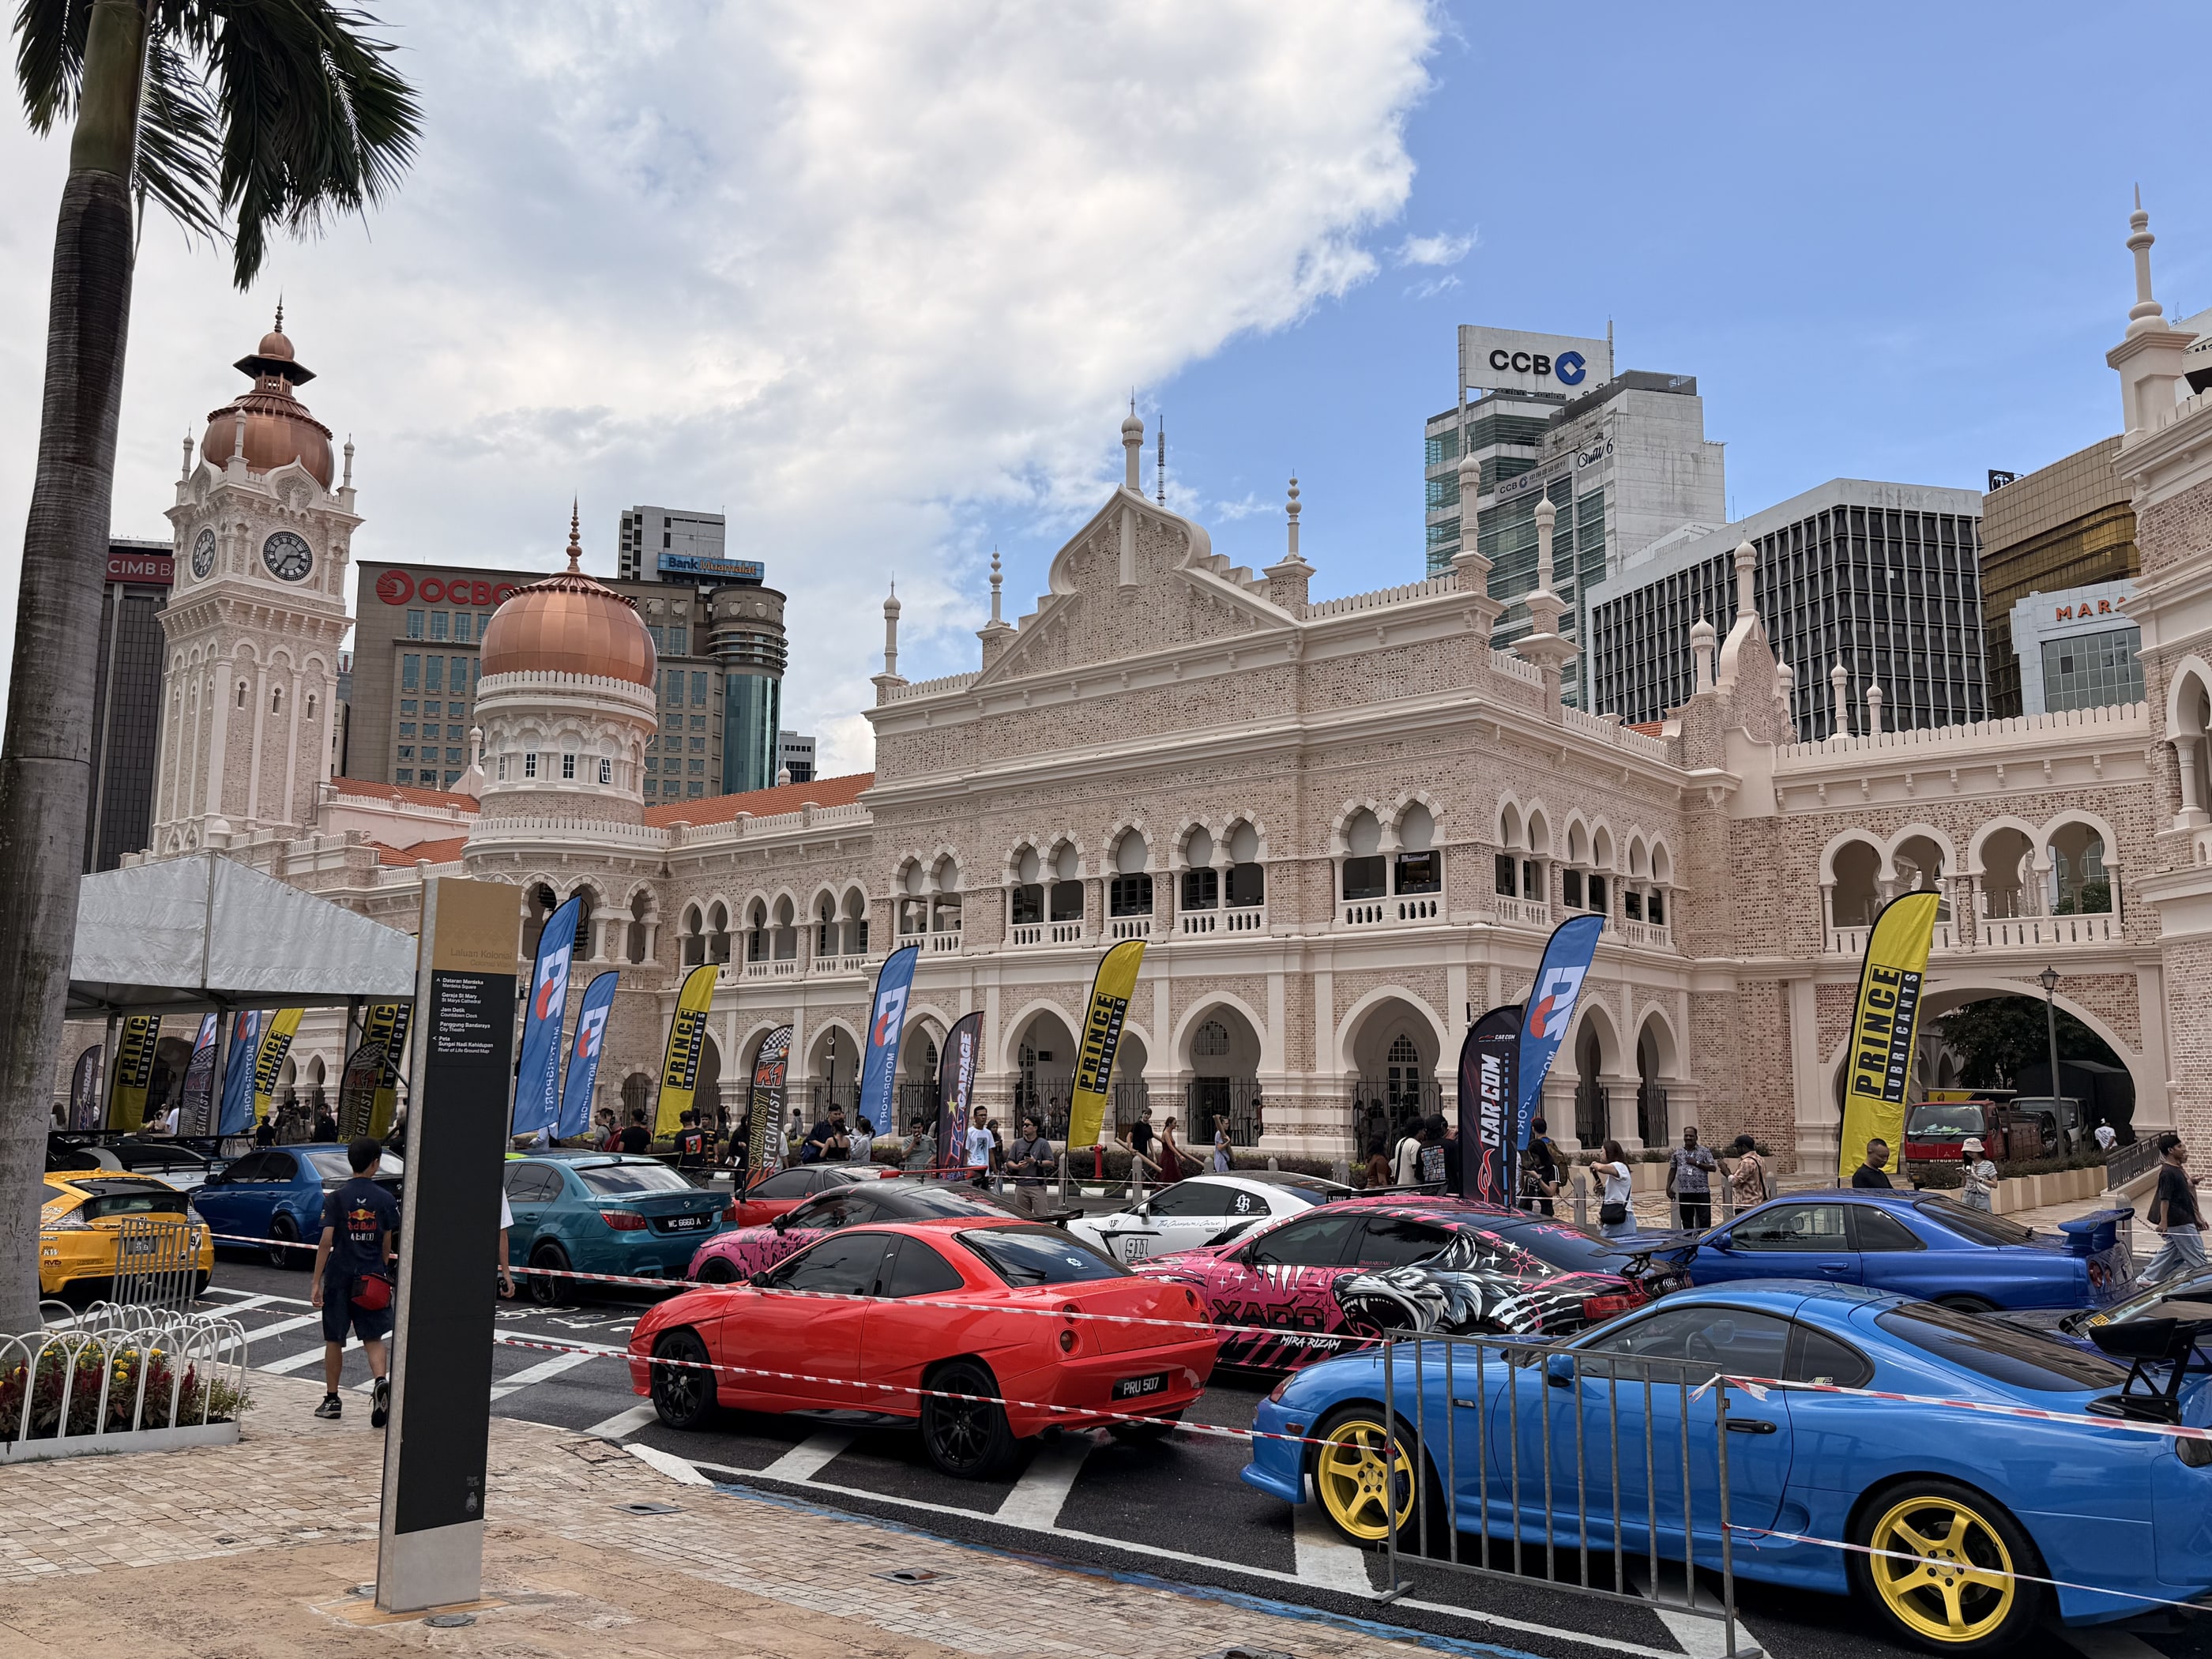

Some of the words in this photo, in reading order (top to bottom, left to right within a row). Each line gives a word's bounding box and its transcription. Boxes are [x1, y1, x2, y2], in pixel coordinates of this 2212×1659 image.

[1490, 350, 1552, 375] CCB
[1578, 445, 1605, 468] Quill
[1607, 437, 1613, 454] 6
[1499, 482, 1518, 494] CCB
[107, 560, 156, 575] CIMB
[669, 557, 698, 570] Bank
[699, 559, 757, 575] Muamalat
[419, 577, 515, 607] OCBC
[450, 948, 478, 957] Laluan
[481, 950, 513, 960] Kolonial
[120, 1016, 148, 1087] PRINC
[136, 1015, 160, 1088] LUBRICANT
[383, 1003, 410, 1088] LURICANT
[667, 1010, 697, 1088] PRINCE
[683, 1013, 705, 1089] LUBRICANTS
[1079, 995, 1115, 1090] PRINCE
[1096, 999, 1127, 1093] LUBRICANTS
[1855, 968, 1901, 1096] PRINCE
[1886, 972, 1918, 1100] LUBRICANTS
[82, 1055, 93, 1102] GARAGE
[255, 1031, 284, 1093] PRINCE
[264, 1035, 292, 1096] LUBRICANTS
[754, 1060, 786, 1089] K1
[957, 1030, 972, 1108] GARAGE
[1480, 1053, 1501, 1101] COM
[180, 1093, 201, 1136] HAUST
[195, 1092, 210, 1136] ECIALIST
[338, 1092, 360, 1139] HAUST
[356, 1092, 374, 1135] CIALIST
[748, 1089, 771, 1171] EXHAUST
[763, 1092, 781, 1168] SPECIALIST
[1480, 1104, 1501, 1147] CAR
[360, 1221, 377, 1230] Bull
[1125, 1238, 1149, 1258] 911
[1212, 1299, 1325, 1334] XADO
[1280, 1334, 1307, 1348] MIRA
[1307, 1337, 1341, 1351] RIZAM
[1123, 1379, 1142, 1395] PRU
[1142, 1376, 1160, 1391] 507
